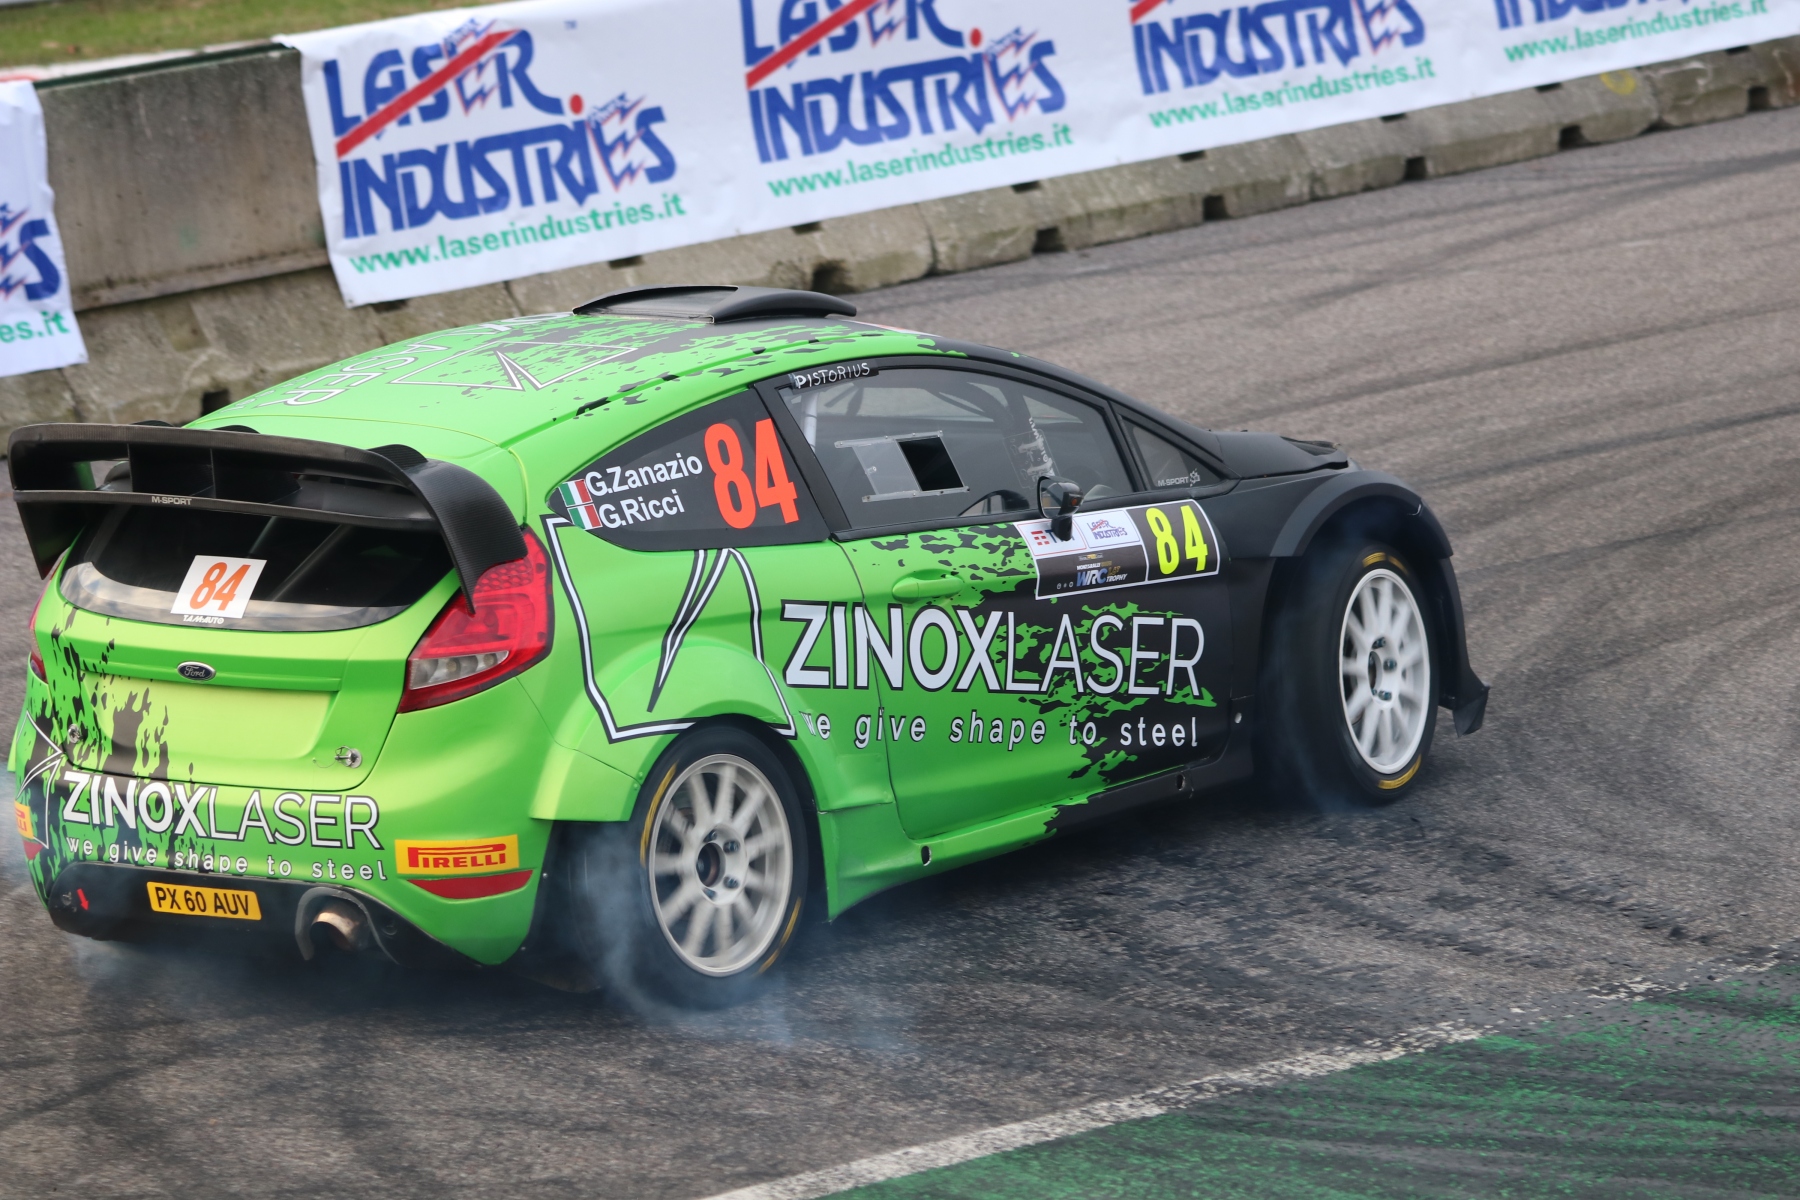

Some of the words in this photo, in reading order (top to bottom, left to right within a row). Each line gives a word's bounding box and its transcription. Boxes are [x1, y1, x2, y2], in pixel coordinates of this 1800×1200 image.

[323, 20, 565, 140] LASER
[748, 27, 1068, 164] INDUSTRIES
[1149, 56, 1436, 130] www.laserindustries.it
[340, 93, 676, 239] INDUSTRIES
[768, 122, 1074, 198] www.laserindustries.it
[349, 192, 688, 275] www.laserindustries.it
[794, 361, 871, 389] PISTORIUS
[585, 452, 704, 497] G.Zanazio
[703, 417, 800, 530] 84
[1157, 476, 1189, 487] M-SPORT
[151, 495, 193, 506] M-SPORT
[597, 489, 686, 529] G.Ricci
[1145, 504, 1209, 575] 84
[189, 561, 252, 612] 84
[1076, 567, 1109, 587] WRC
[1105, 573, 1128, 583] TROPHY
[183, 665, 206, 678] Ford
[782, 600, 1206, 697] ZINOXLASER
[853, 706, 927, 750] give
[948, 709, 1047, 752] shape
[1068, 713, 1097, 746] to
[1119, 715, 1199, 748] steel
[61, 769, 386, 851] ZINOXLASER
[66, 836, 93, 856] we
[108, 840, 157, 864] give
[174, 850, 249, 874] shape
[266, 855, 293, 877] to
[311, 859, 388, 882] steel
[407, 843, 507, 869] PIRELLI
[155, 887, 181, 909] PX
[183, 890, 207, 913] 60
[212, 893, 250, 916] AUV
